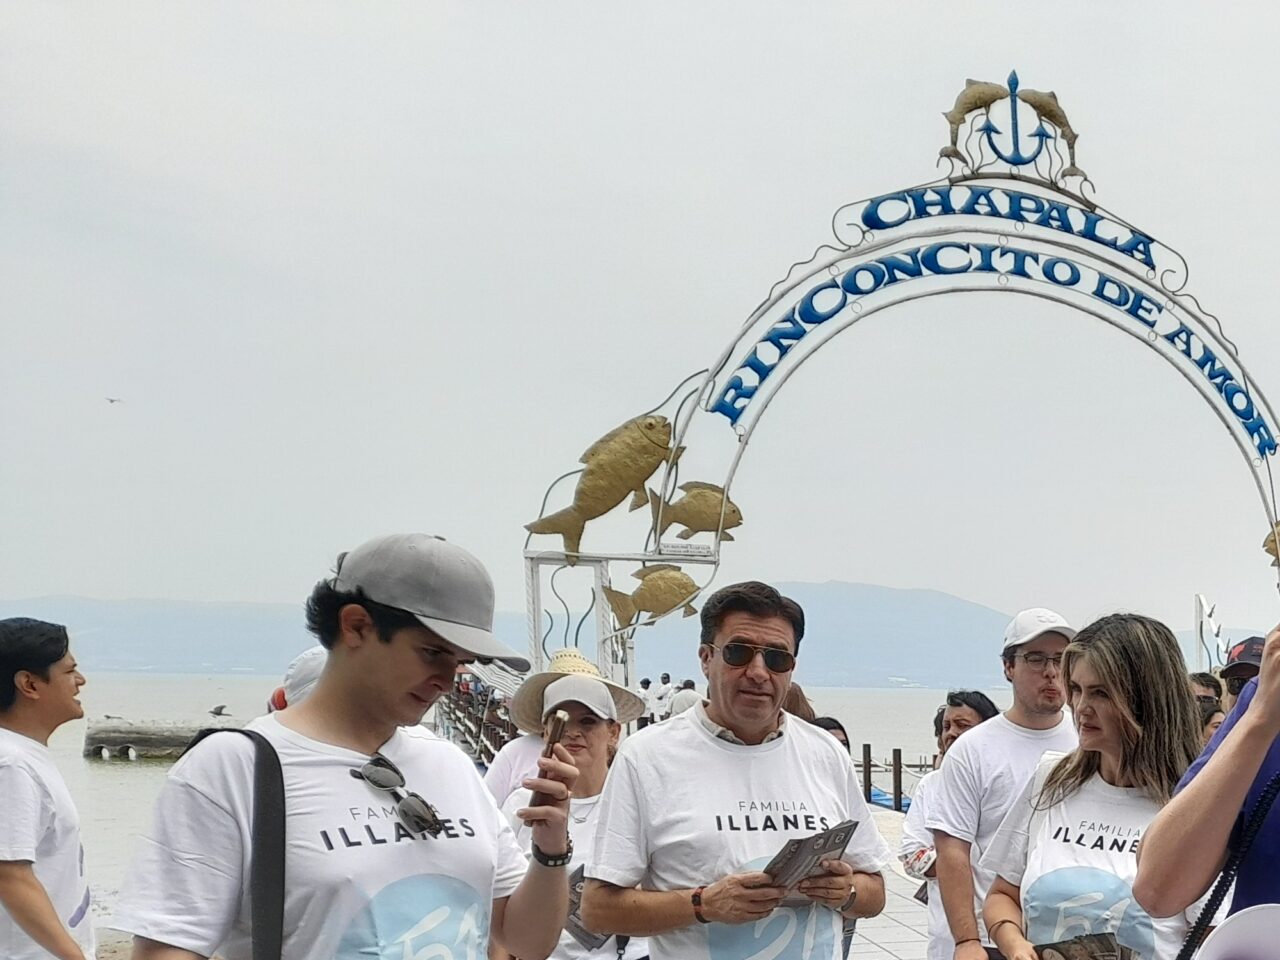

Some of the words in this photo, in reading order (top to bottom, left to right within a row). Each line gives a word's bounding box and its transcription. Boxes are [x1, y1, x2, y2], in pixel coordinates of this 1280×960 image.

[861, 185, 1157, 271] CHAPALA
[710, 242, 1081, 428] RINCONCITO
[1092, 271, 1164, 328] DE
[1163, 325, 1279, 459] AMOR
[349, 804, 441, 820] FAMA
[739, 801, 808, 812] FAMILIA
[716, 815, 830, 832] ILLANES
[1078, 821, 1141, 837] FAMILIA
[1053, 826, 1140, 853] ILLANE
